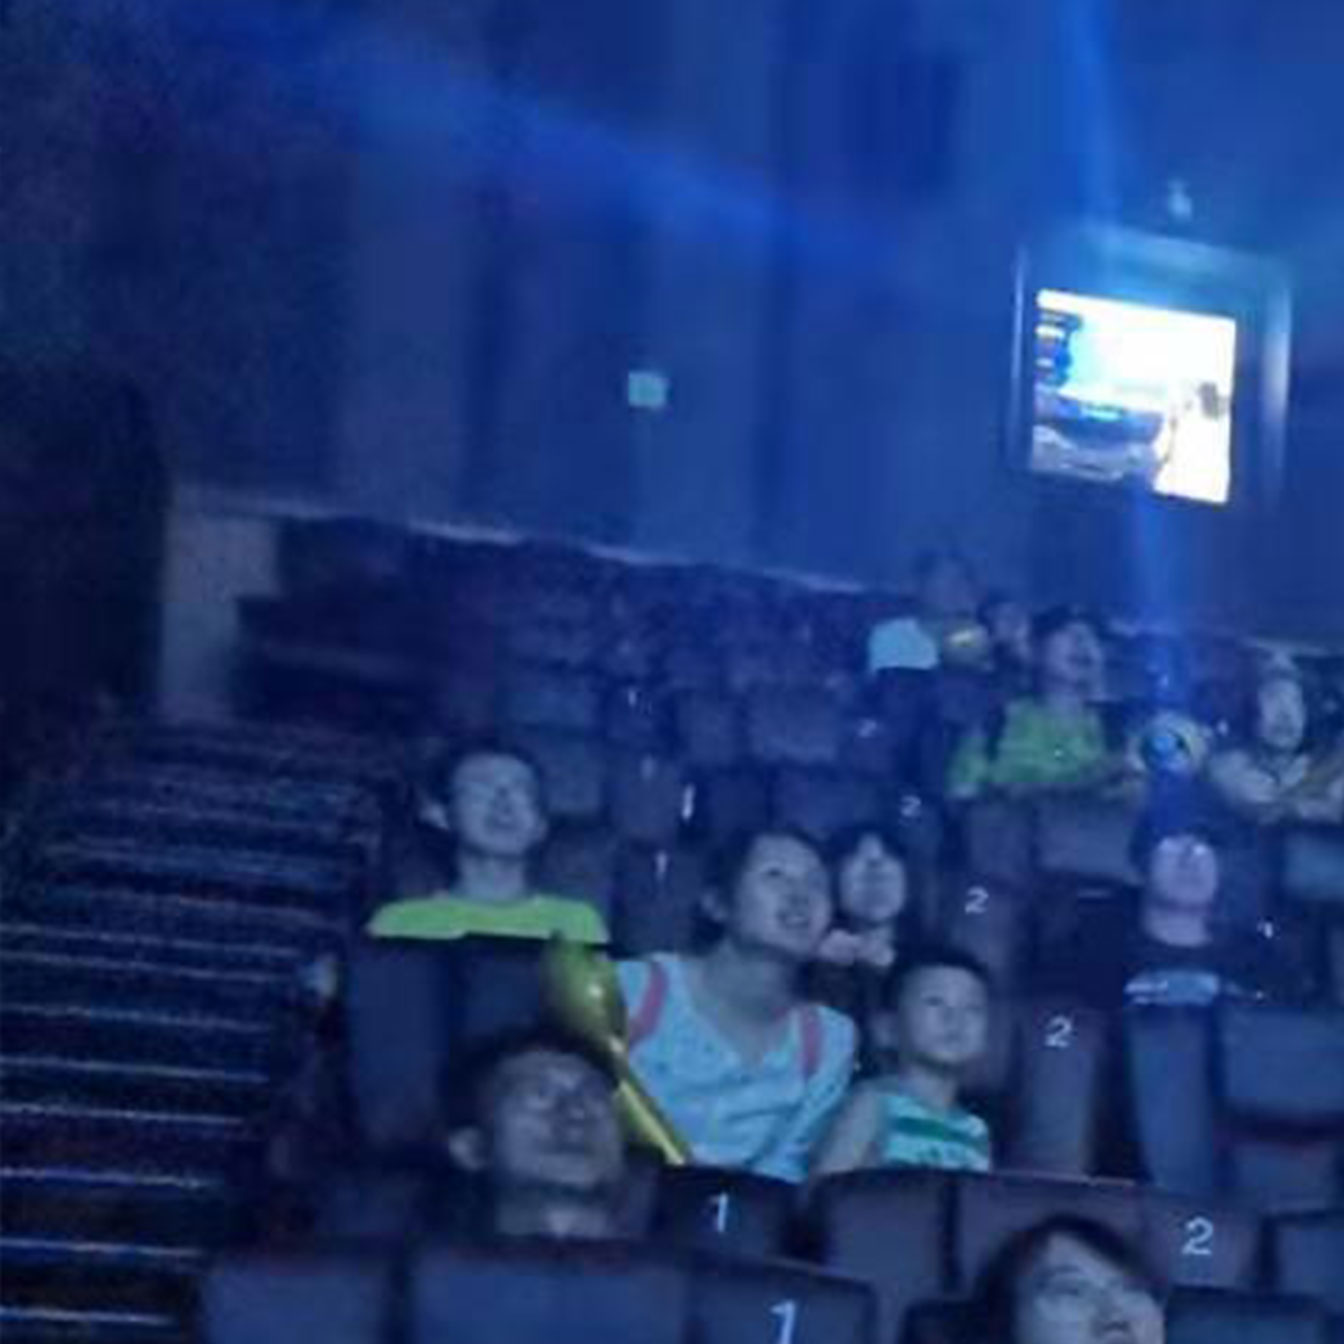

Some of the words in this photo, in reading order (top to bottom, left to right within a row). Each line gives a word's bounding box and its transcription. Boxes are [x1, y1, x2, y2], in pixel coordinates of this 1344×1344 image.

[964, 885, 989, 915] 2
[1045, 1016, 1074, 1048] 2
[706, 1190, 730, 1234] 1
[1181, 1216, 1214, 1256] 2
